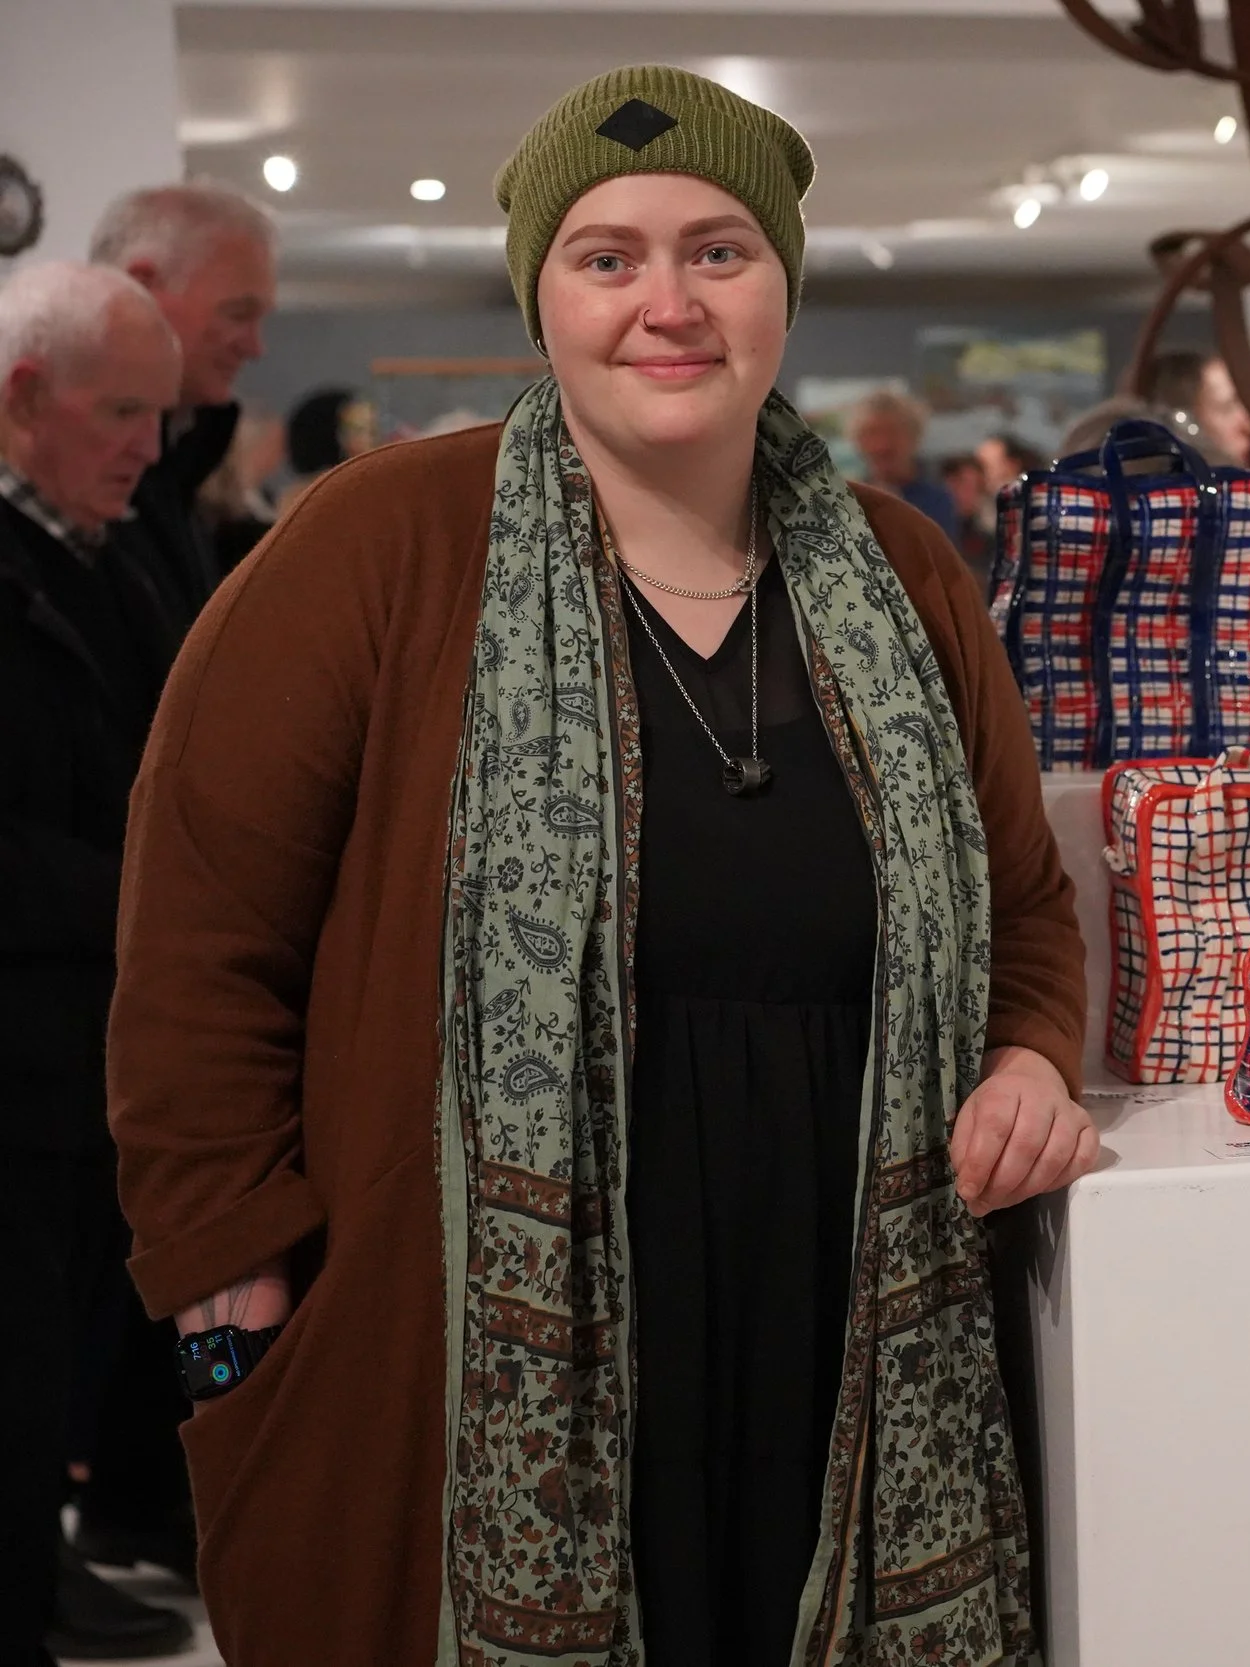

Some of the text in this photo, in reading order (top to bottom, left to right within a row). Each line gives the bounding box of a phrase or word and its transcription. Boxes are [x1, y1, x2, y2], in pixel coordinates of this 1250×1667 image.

[206, 1337, 216, 1350] 35
[214, 1334, 223, 1343] 11
[190, 1342, 201, 1360] 7:16
